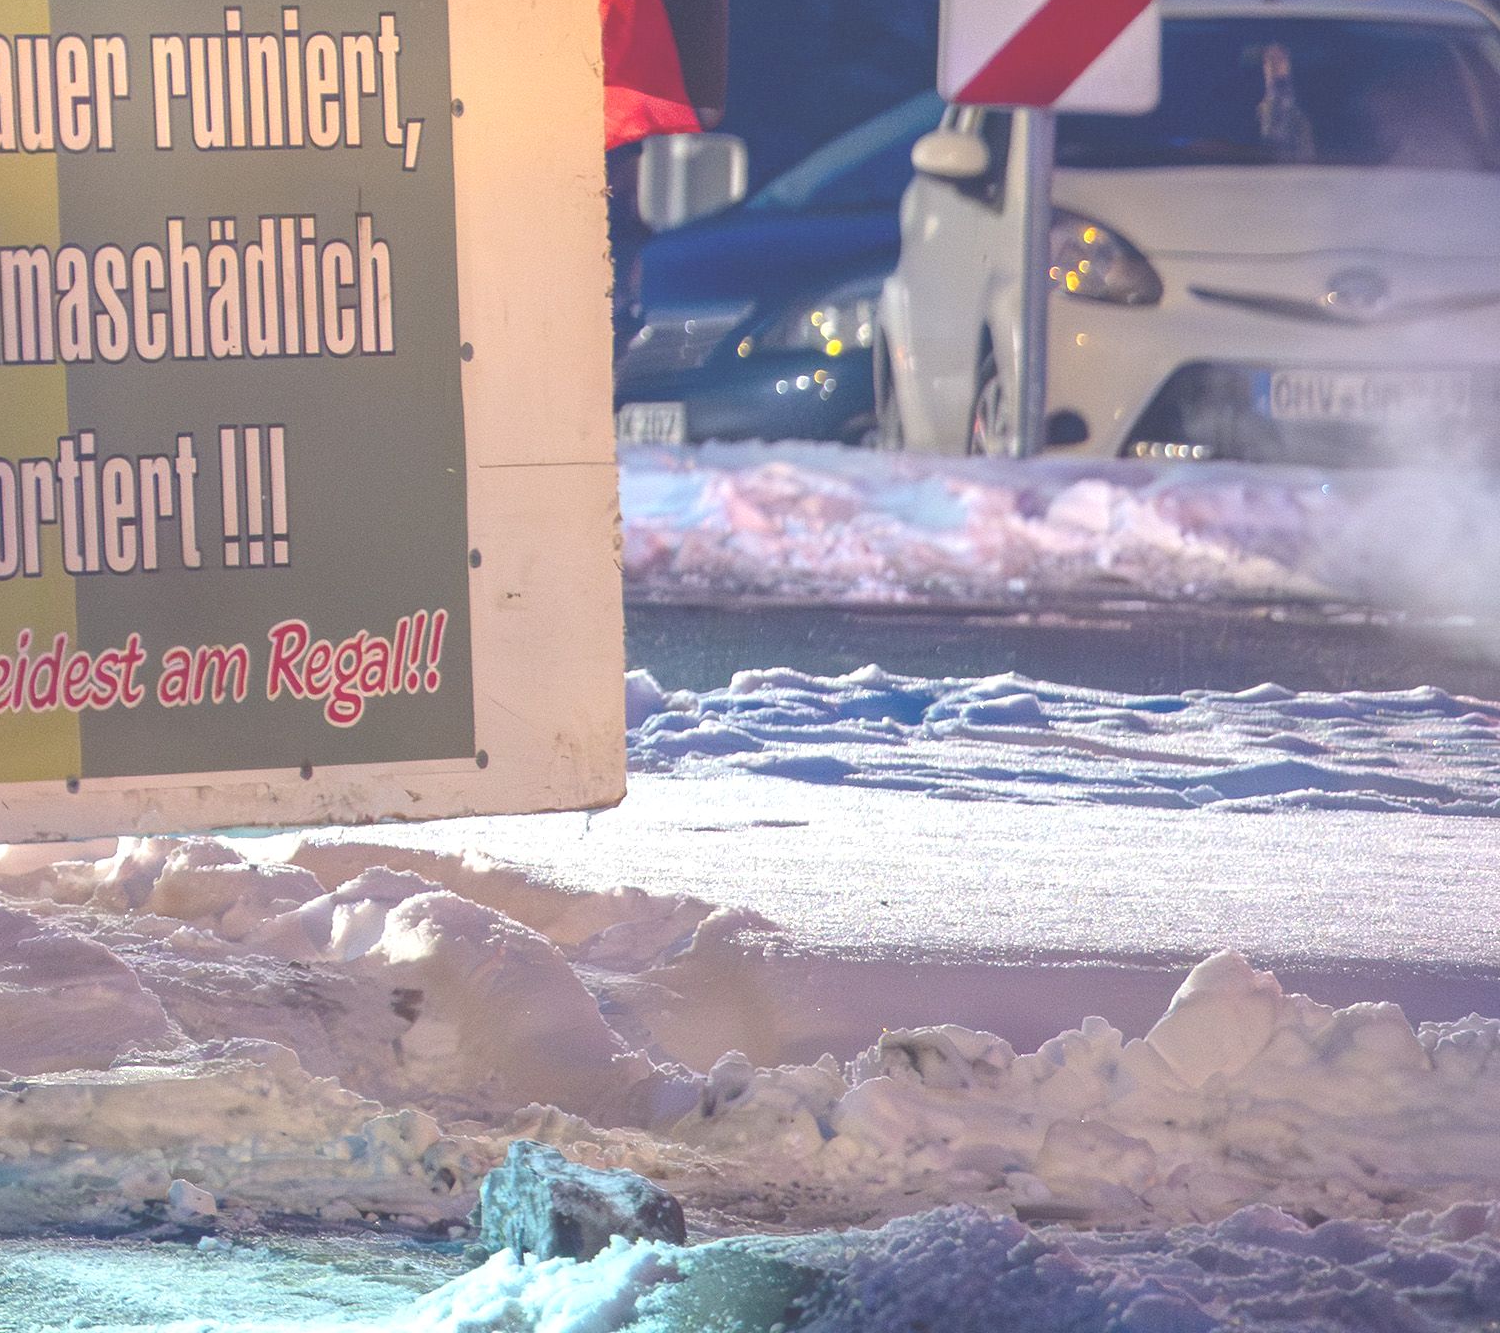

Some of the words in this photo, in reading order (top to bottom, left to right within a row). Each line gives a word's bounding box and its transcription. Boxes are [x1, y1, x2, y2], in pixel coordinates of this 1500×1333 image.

[151, 6, 426, 171] ruiniert,
[219, 424, 290, 568] !!!
[156, 641, 248, 705] am
[267, 609, 449, 728] Regal!!
